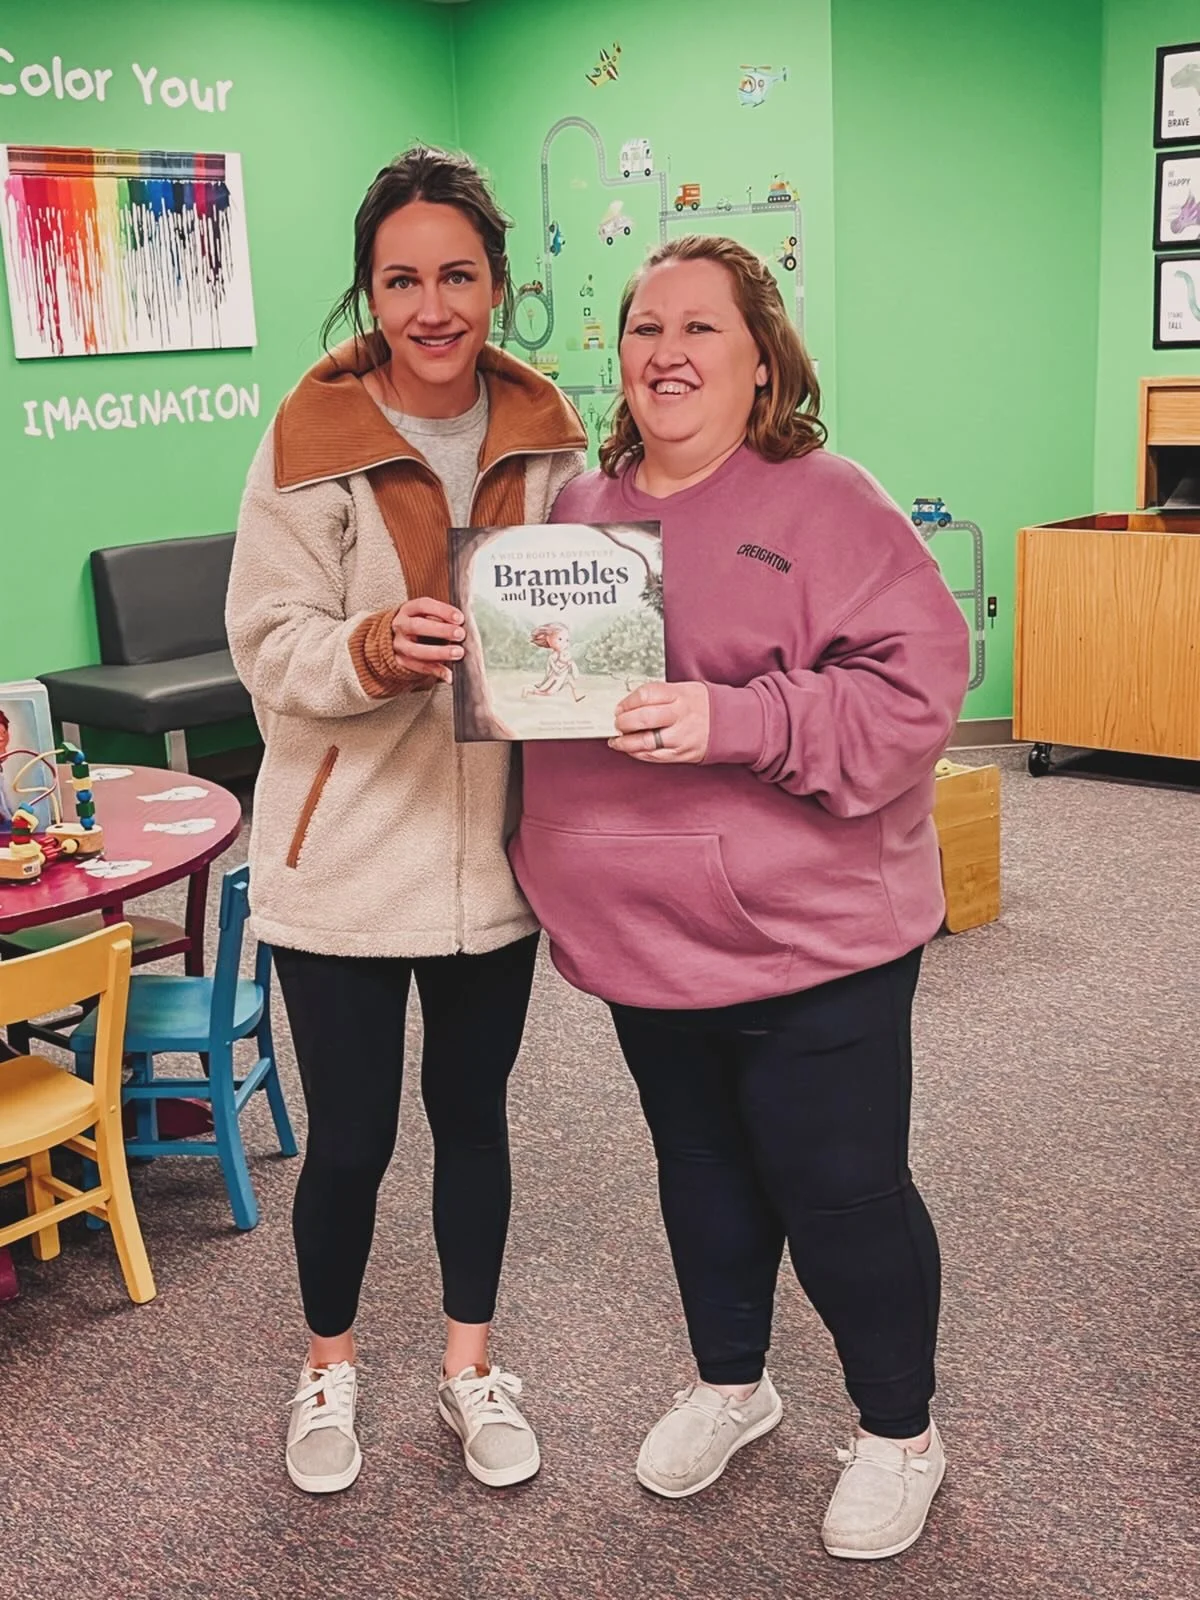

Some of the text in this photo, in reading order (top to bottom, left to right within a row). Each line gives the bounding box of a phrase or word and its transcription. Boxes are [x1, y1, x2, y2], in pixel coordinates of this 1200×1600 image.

[131, 62, 233, 113] Your
[1167, 118, 1190, 128] BRAVE
[1167, 178, 1191, 188] HAPPY
[23, 383, 260, 440] IMAGINATION
[499, 552, 523, 560] WILD
[526, 551, 557, 560] ROOTS
[559, 549, 615, 559] ADVENTURE
[736, 543, 792, 575] CREIGHTON
[493, 560, 629, 588] Brambles
[501, 584, 617, 611] and Beyond
